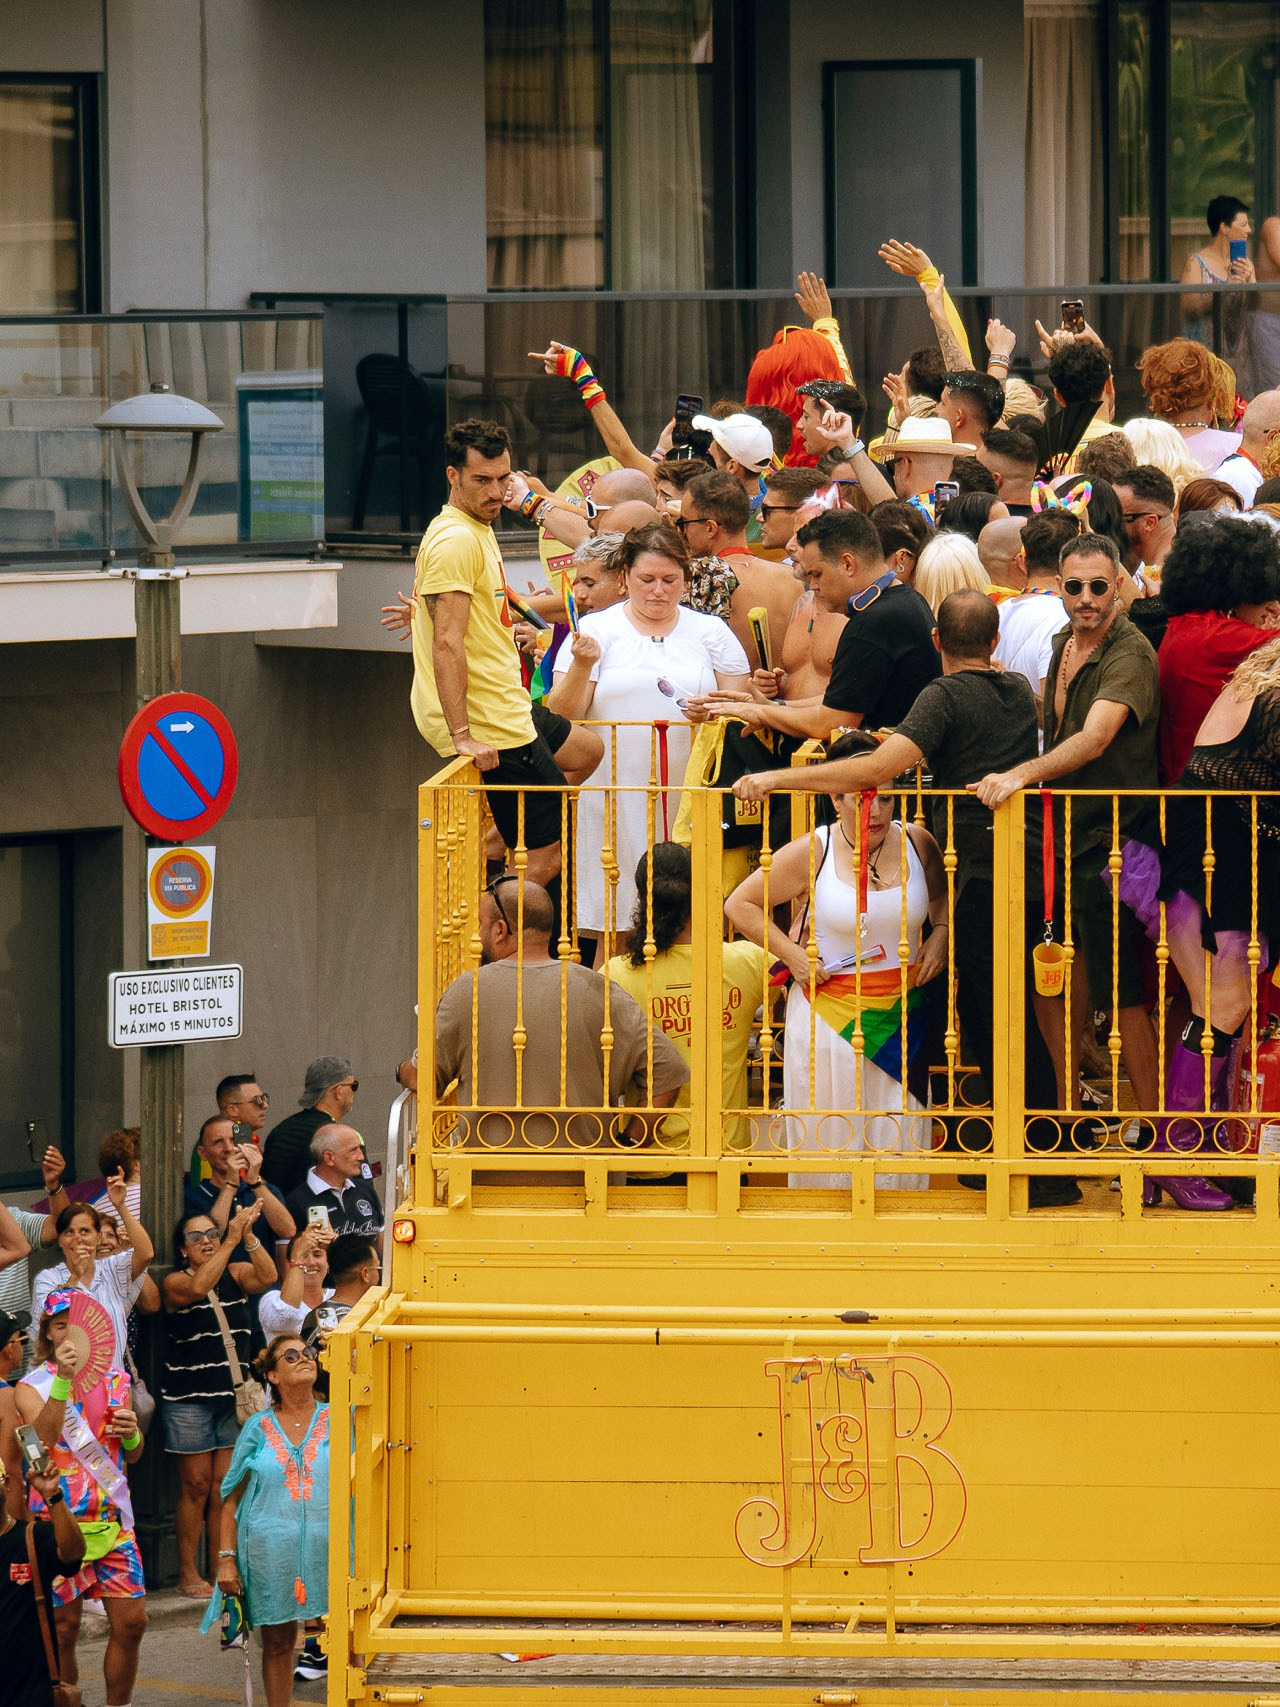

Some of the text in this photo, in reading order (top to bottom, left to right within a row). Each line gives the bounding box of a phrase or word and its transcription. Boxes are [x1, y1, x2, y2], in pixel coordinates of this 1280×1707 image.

[737, 799, 759, 817] J&B
[119, 974, 234, 997] USO EXCLUSIVO CLIENTES
[129, 997, 223, 1015] HOTEL BRISTOL
[119, 1016, 233, 1036] MÁXIMO 15 MINUTOS
[82, 1305, 111, 1343] PUTO
[80, 1346, 111, 1393] CALOR
[735, 1353, 967, 1568] J&B
